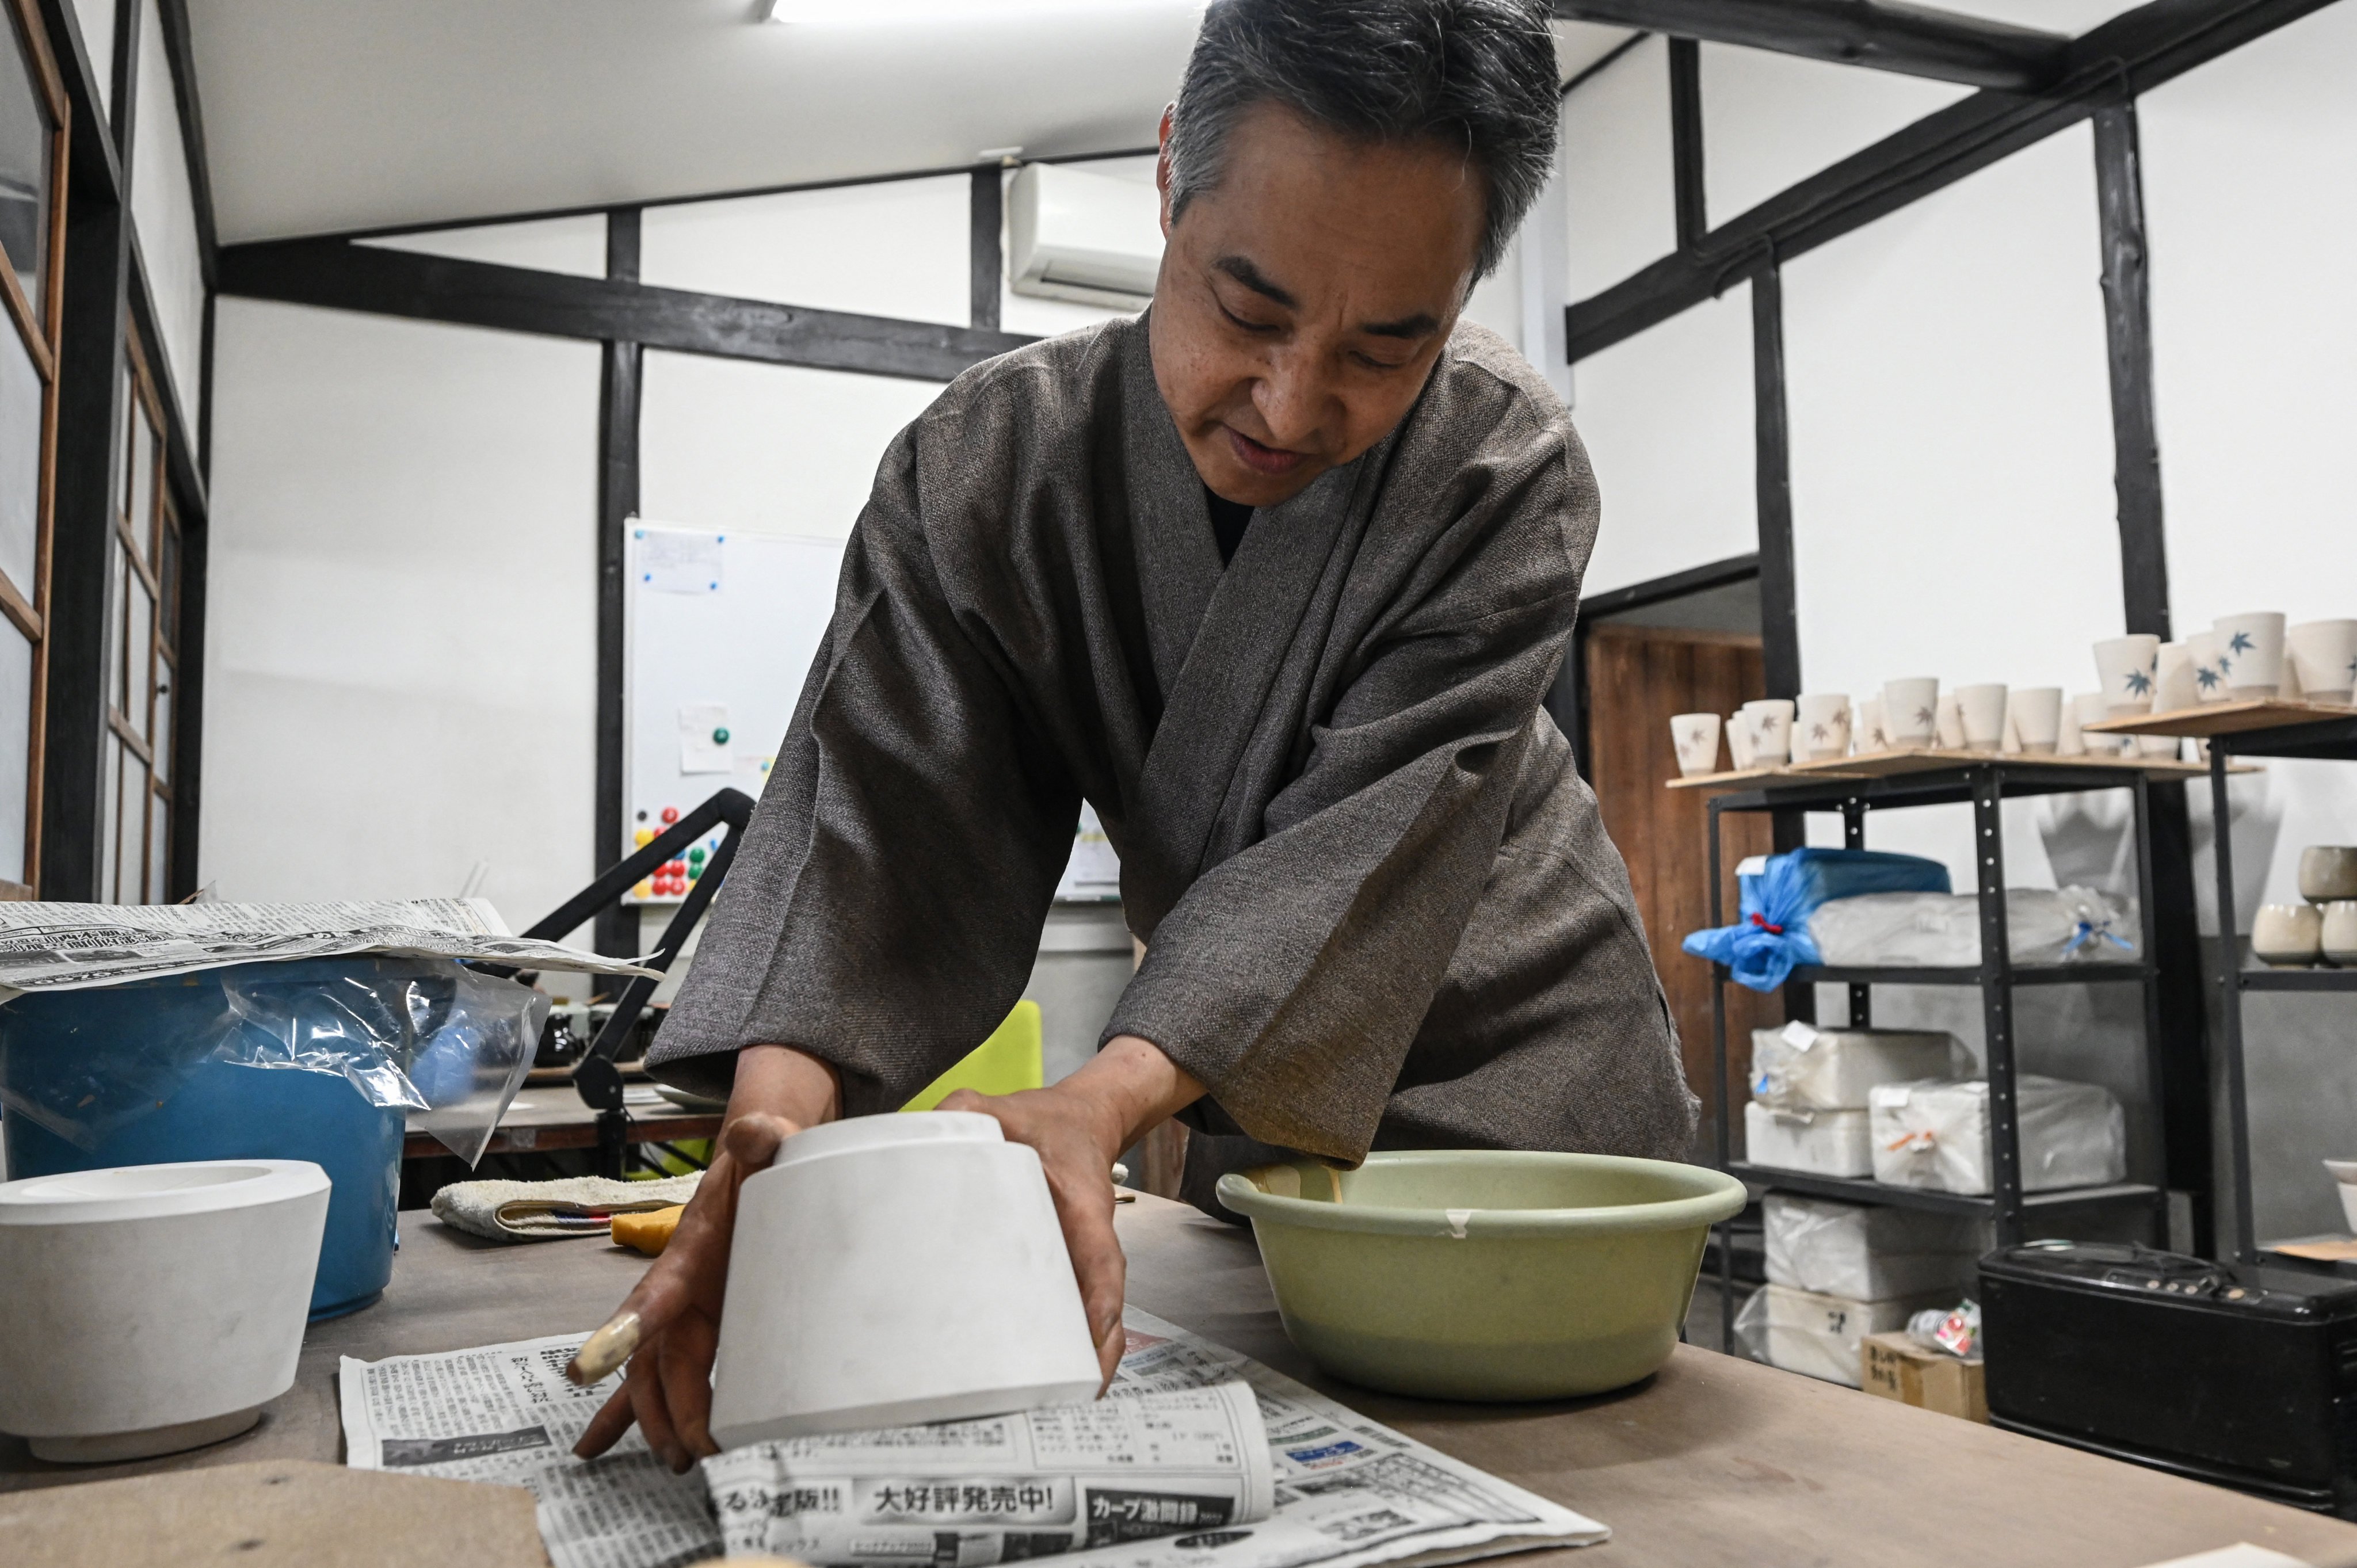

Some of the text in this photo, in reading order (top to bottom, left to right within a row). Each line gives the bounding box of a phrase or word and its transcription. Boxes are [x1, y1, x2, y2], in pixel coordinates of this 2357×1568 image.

[875, 1485, 1054, 1513] 大好評発売中!
